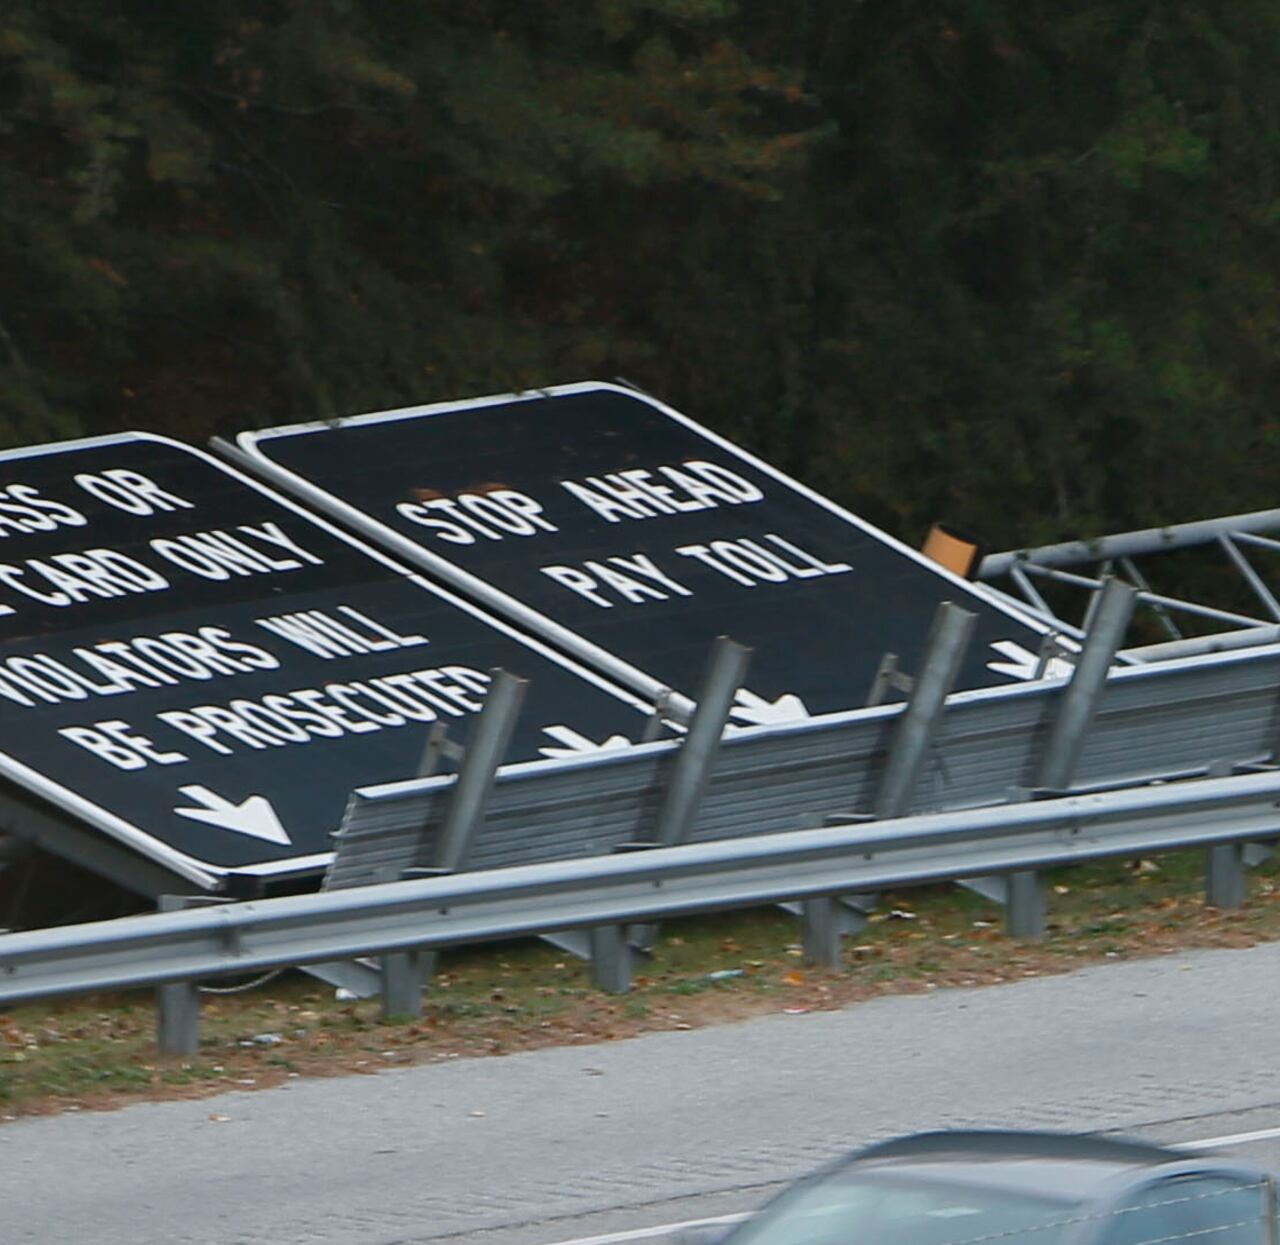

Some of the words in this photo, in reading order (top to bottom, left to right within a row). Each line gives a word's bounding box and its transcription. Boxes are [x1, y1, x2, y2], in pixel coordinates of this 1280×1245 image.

[74, 468, 197, 518] OR
[395, 488, 559, 546] STOP
[561, 460, 764, 524] AHEAD
[149, 521, 325, 582] ONLY
[540, 552, 693, 608] PAY
[673, 533, 853, 587] TOLL
[255, 604, 430, 661] WILL
[58, 719, 187, 772] BE
